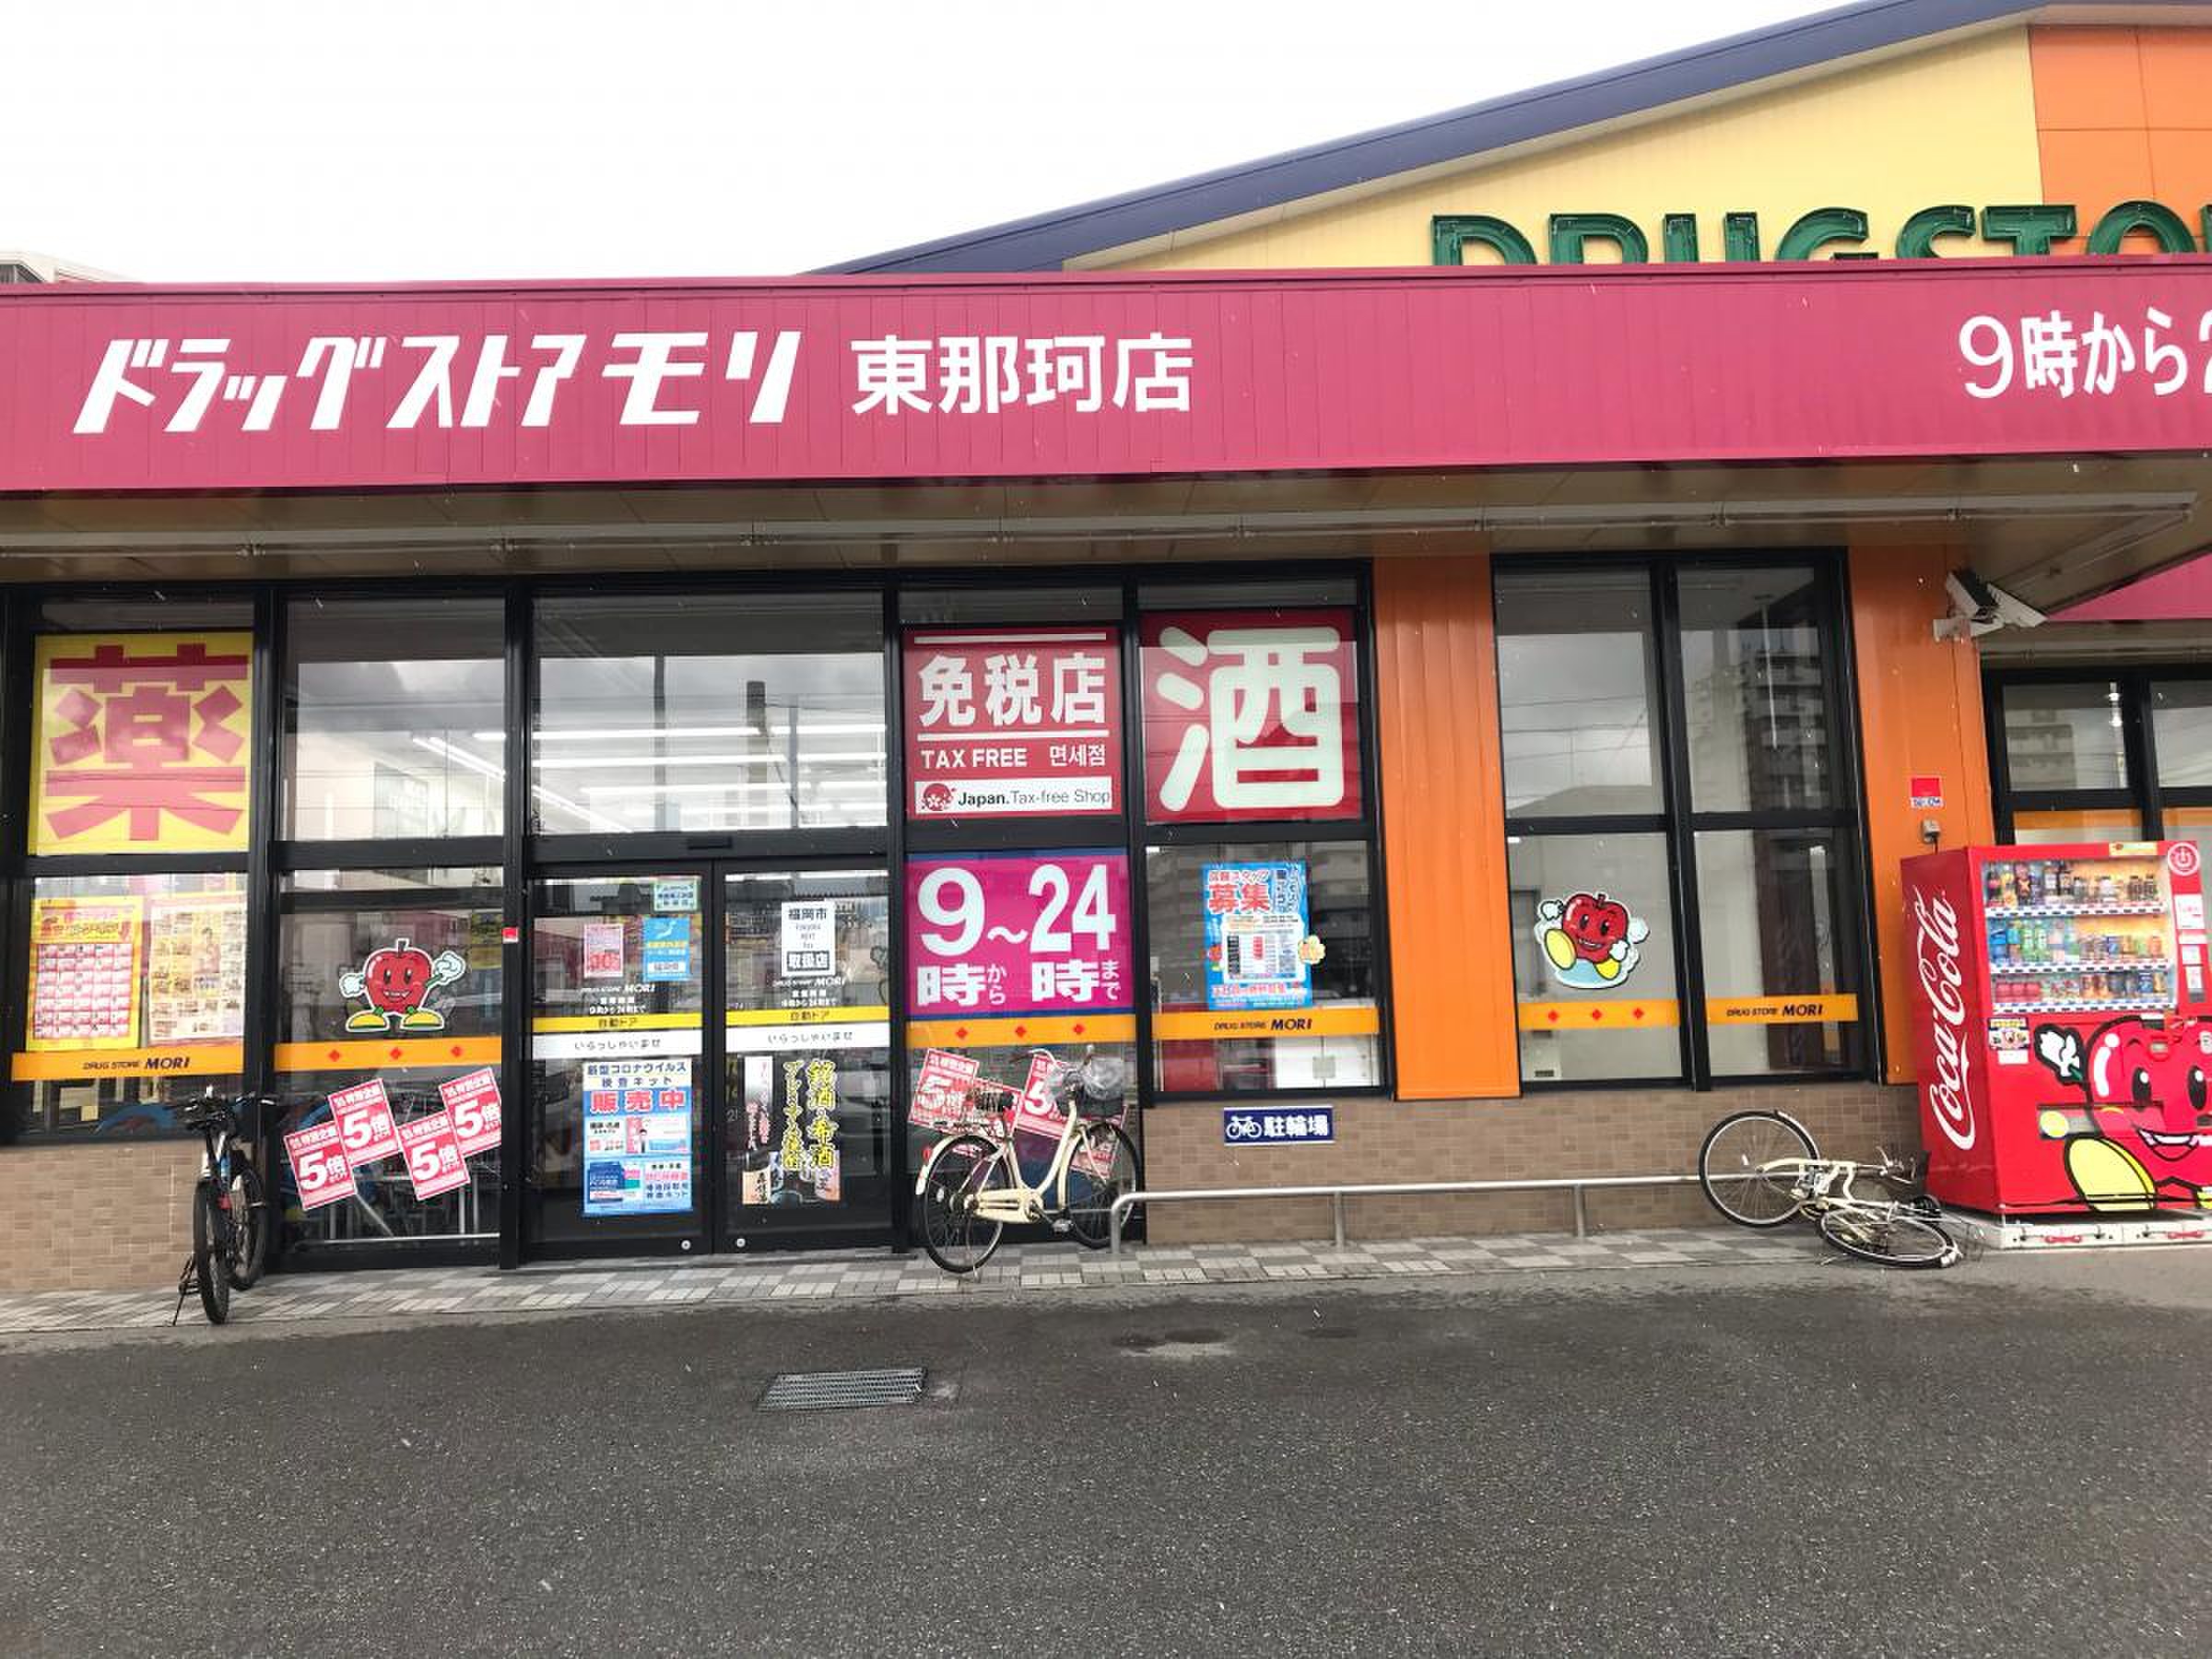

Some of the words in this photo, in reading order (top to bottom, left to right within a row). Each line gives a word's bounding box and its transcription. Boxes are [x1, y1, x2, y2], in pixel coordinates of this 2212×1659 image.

[851, 332, 1194, 415] 東那珂店
[918, 653, 1105, 726] 免税店
[1156, 627, 1345, 812] 酒
[45, 642, 249, 841] 薬
[921, 750, 966, 769] TAX
[972, 748, 1028, 768] FREE
[1050, 744, 1106, 767] 면세점
[1074, 787, 1110, 804] Shop
[1208, 884, 1271, 913] 募集
[790, 1010, 830, 1021] 自動ドア
[1783, 1004, 1823, 1017] MORI
[1913, 885, 1975, 1149] Coca-Cola
[598, 1018, 638, 1028] 自動ドア
[1271, 1018, 1312, 1030] MORI
[768, 1031, 853, 1044] いらっしゃいませ
[145, 1057, 190, 1069] MORI
[587, 1061, 687, 1076] 新型コロナウイルス
[591, 1089, 686, 1113] 販売中
[1264, 1114, 1328, 1137] 駐輪場
